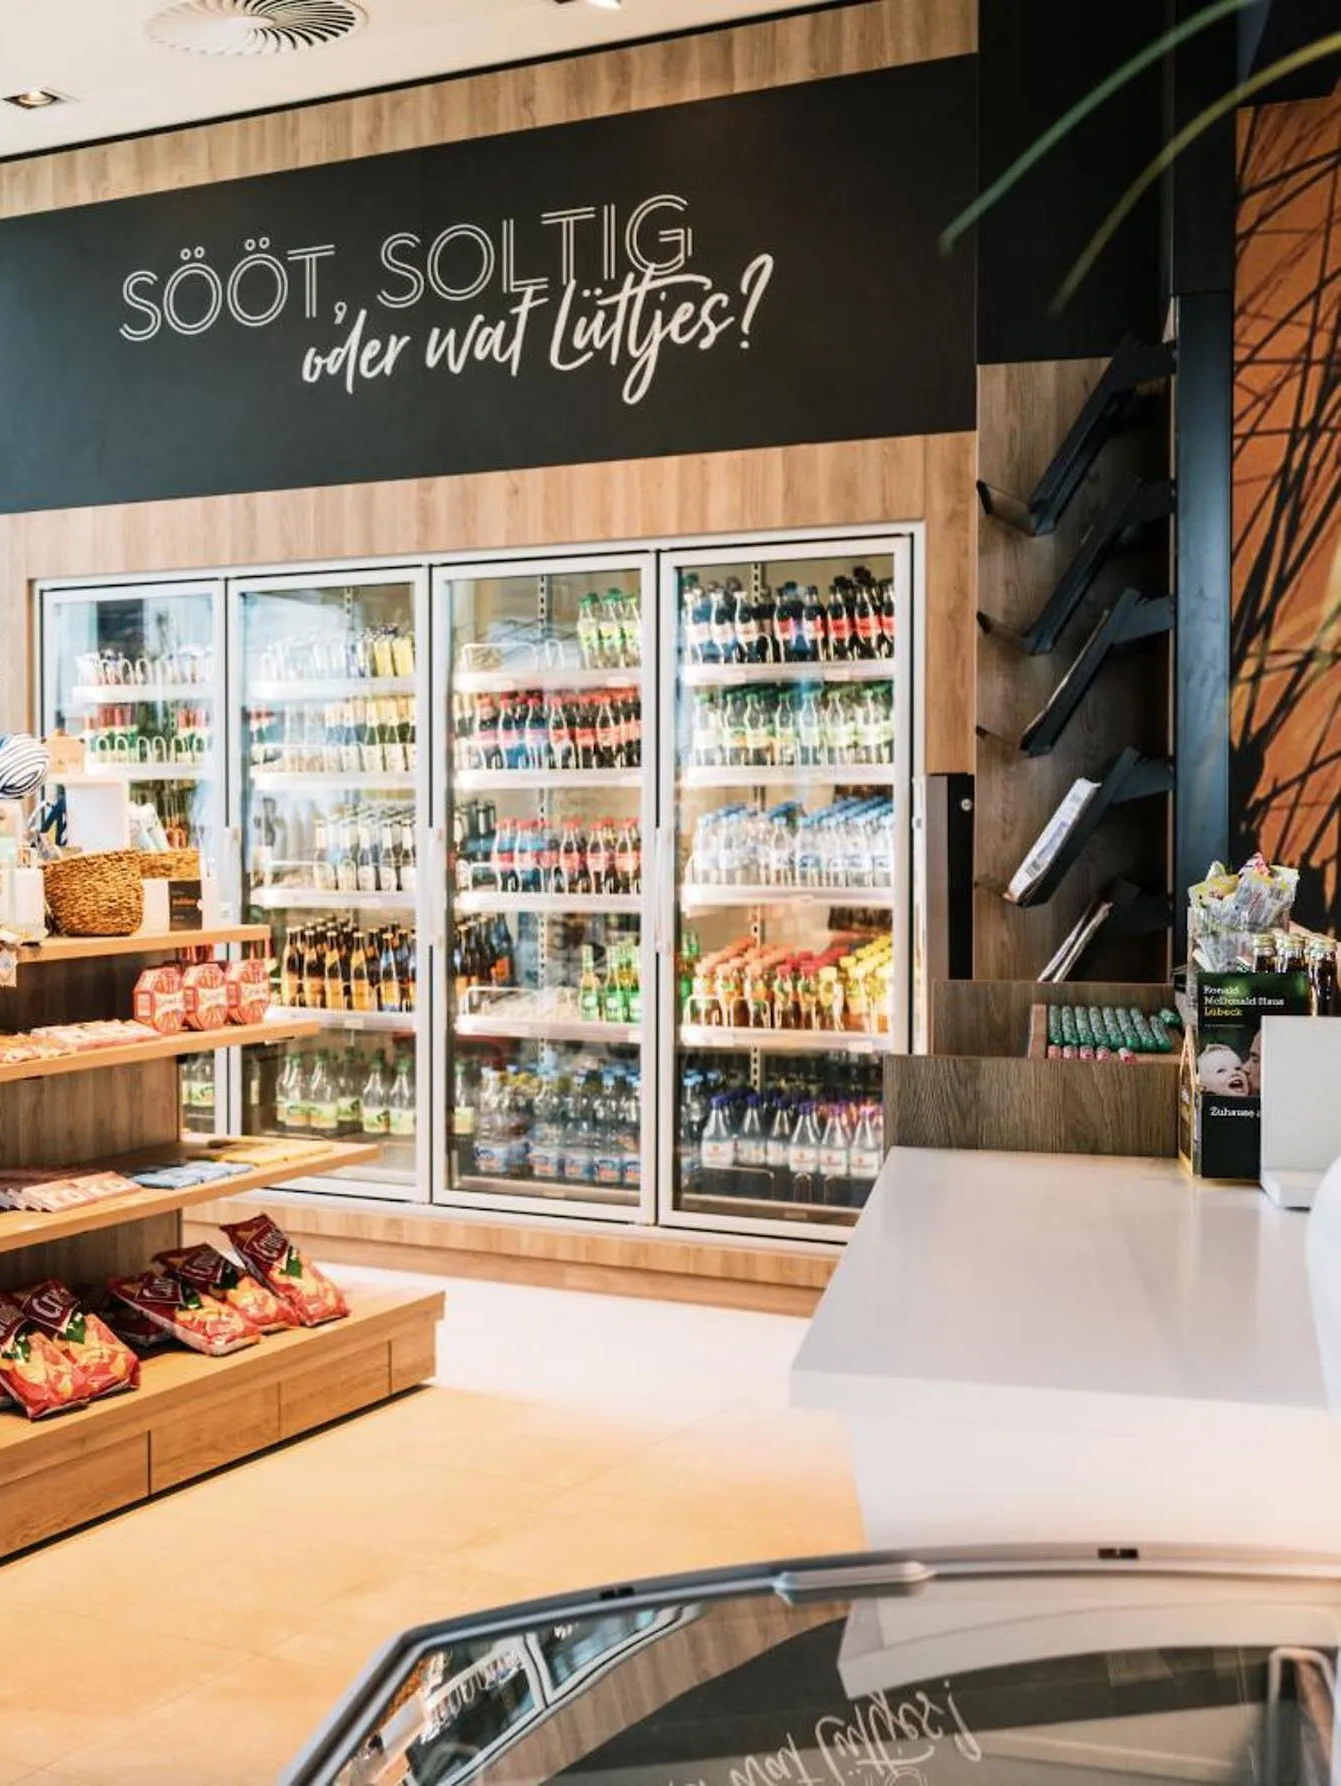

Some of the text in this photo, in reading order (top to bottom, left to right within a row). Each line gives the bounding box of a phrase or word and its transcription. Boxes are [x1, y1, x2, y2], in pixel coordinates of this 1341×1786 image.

[118, 195, 693, 342] SÖÖT, SOLTIG
[301, 253, 774, 405] oder wat Lüttjes?
